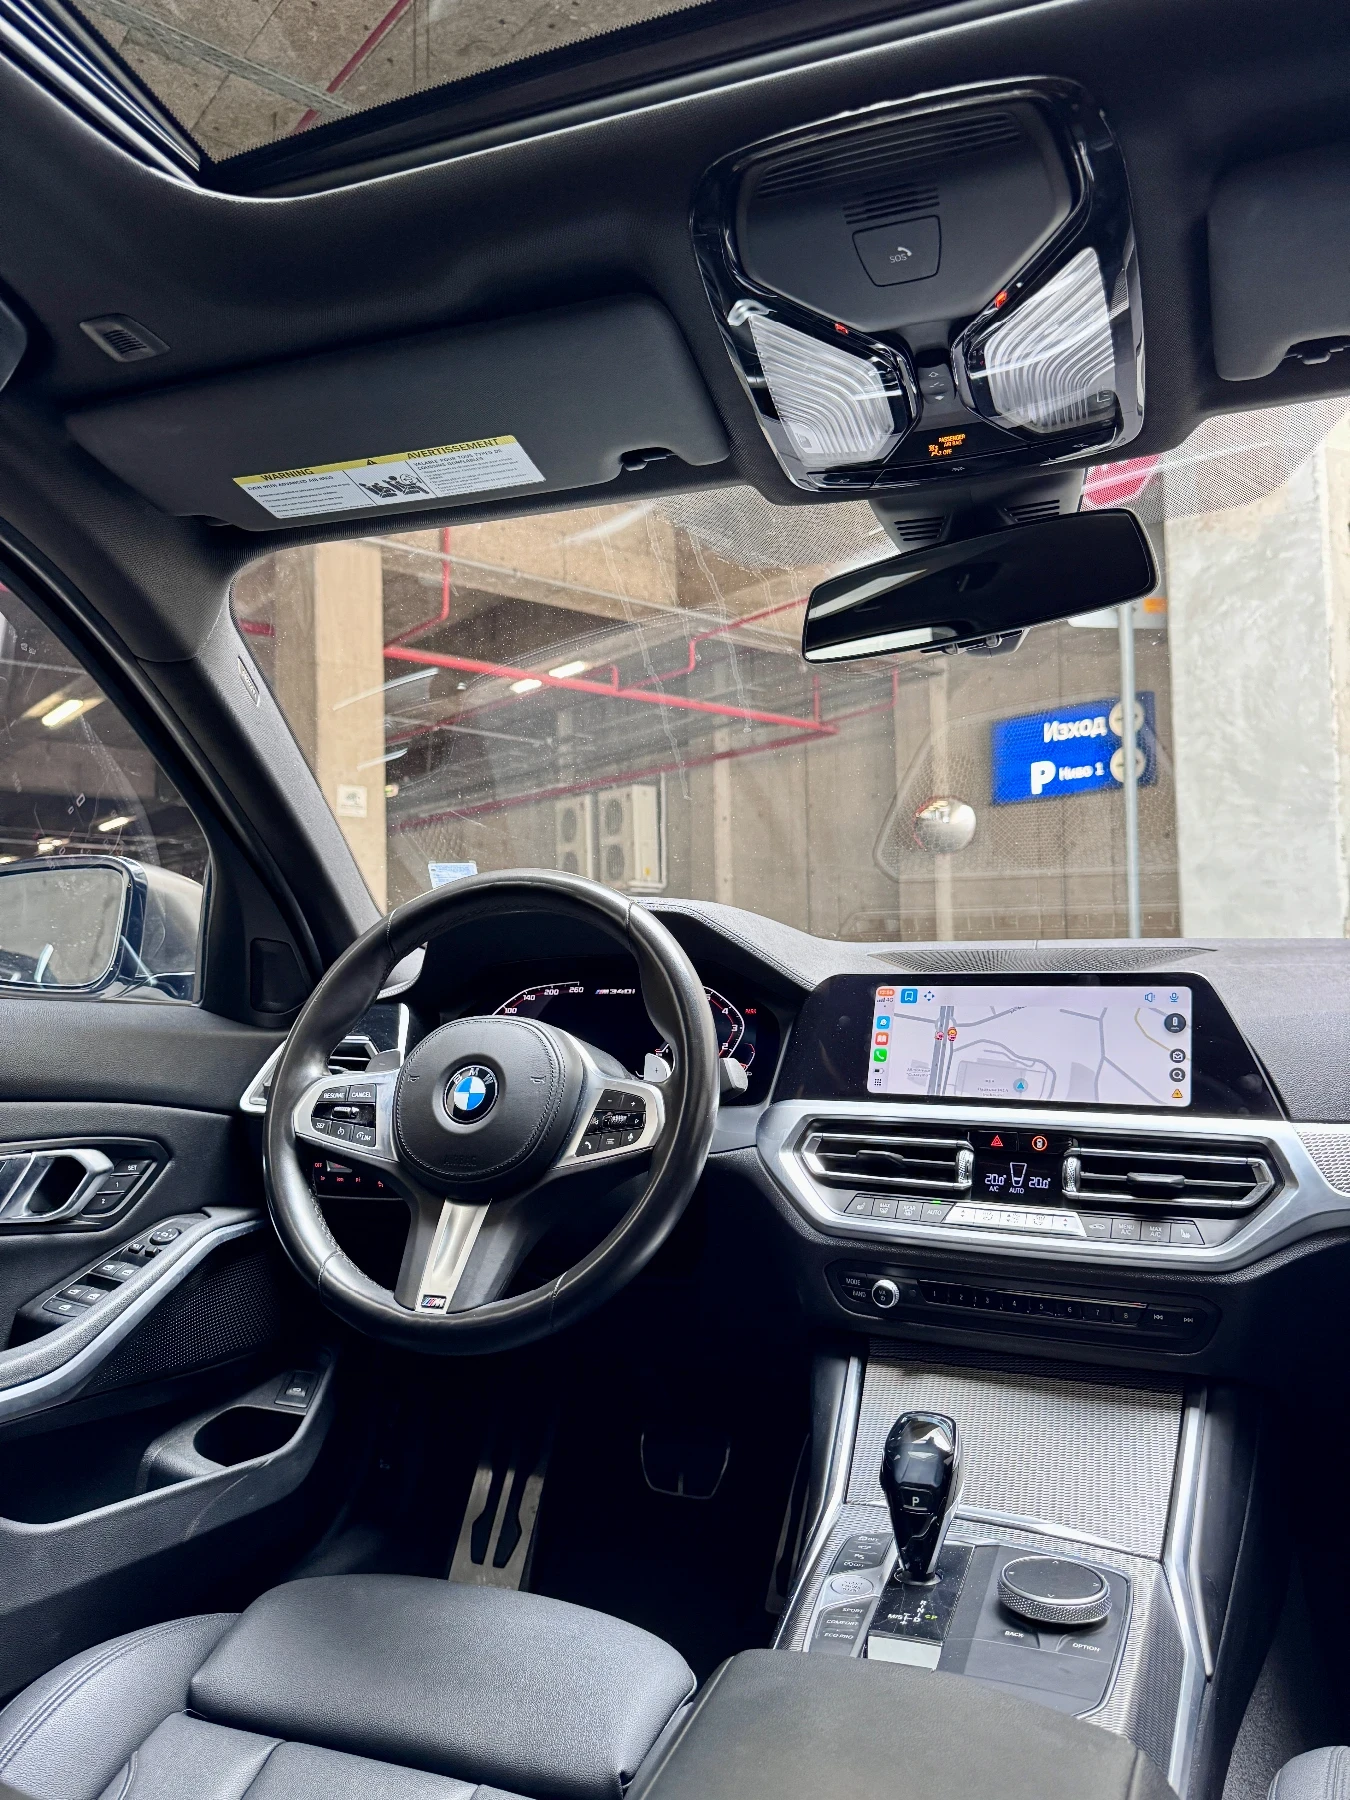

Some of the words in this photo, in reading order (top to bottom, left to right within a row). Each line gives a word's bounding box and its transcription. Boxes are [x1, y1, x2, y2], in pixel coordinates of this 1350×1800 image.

[890, 253, 908, 263] SOS
[939, 434, 965, 442] PASSENGER
[407, 438, 500, 460] AVERTISSEMENT
[260, 468, 315, 482] WARNING
[1043, 716, 1108, 743] Изход
[1030, 760, 1056, 795] P
[1058, 765, 1094, 781] Ниво
[1094, 762, 1105, 776] 1
[543, 988, 560, 996] 200
[568, 986, 584, 994] 260
[721, 1007, 729, 1015] 4
[731, 1024, 738, 1032] 3
[721, 1042, 729, 1050] 2
[453, 1067, 494, 1085] BMW
[845, 1277, 861, 1286] MODE
[985, 1296, 990, 1304] 3
[912, 1496, 920, 1507] P
[1004, 1630, 1024, 1638] BACK
[1072, 1642, 1101, 1653] OPTION
